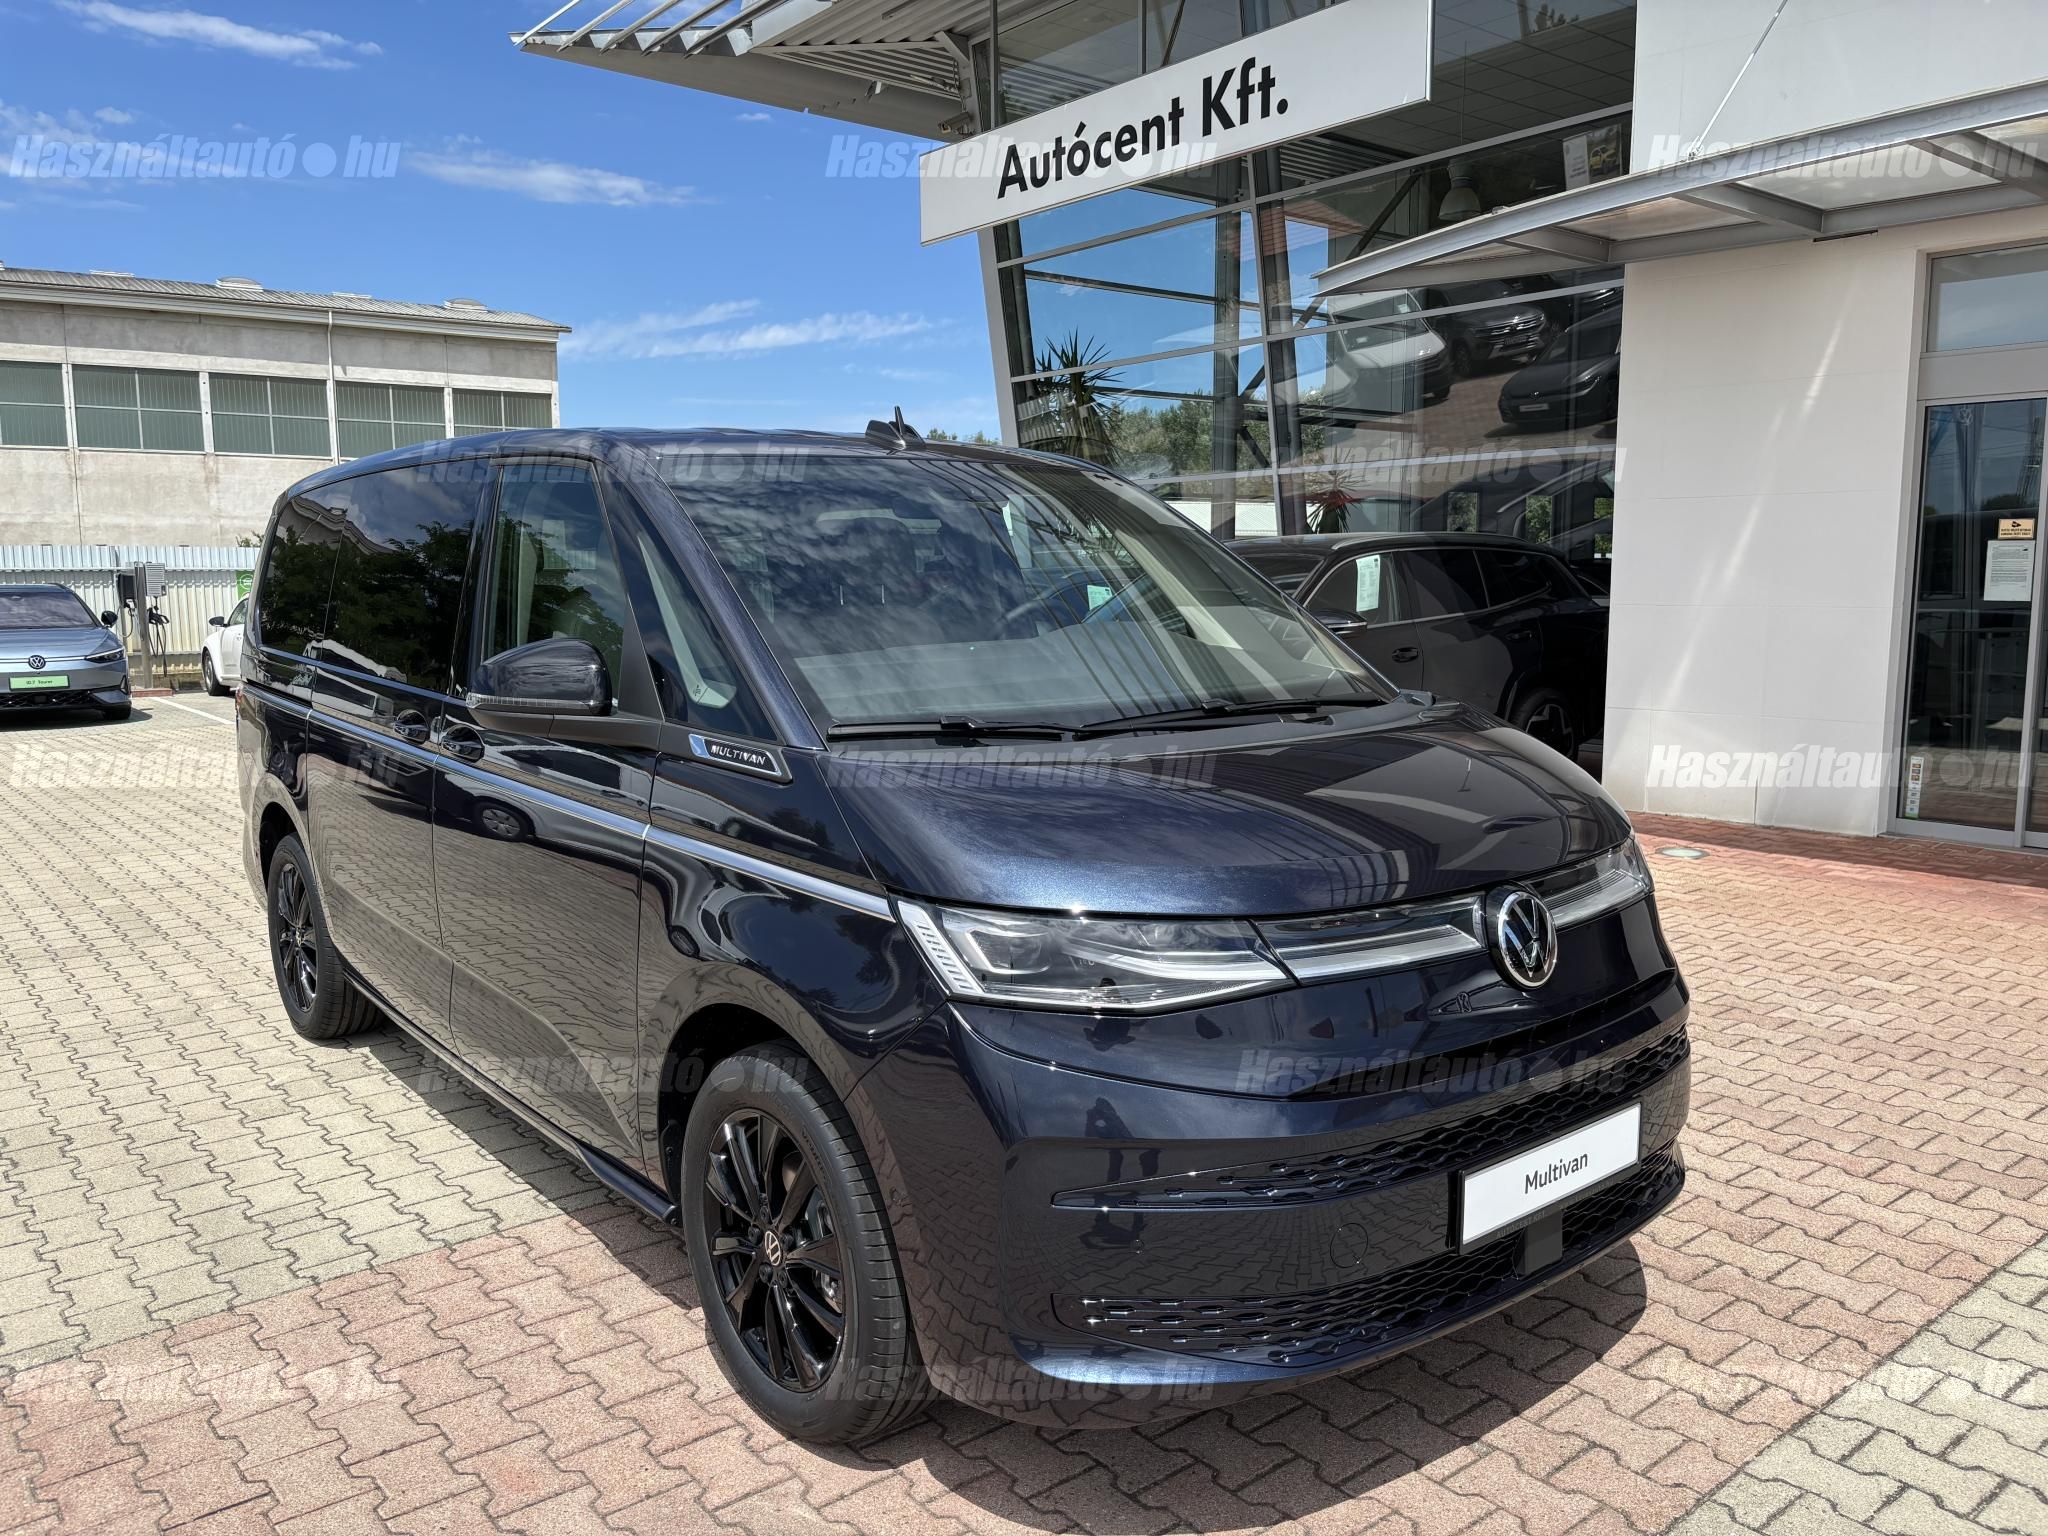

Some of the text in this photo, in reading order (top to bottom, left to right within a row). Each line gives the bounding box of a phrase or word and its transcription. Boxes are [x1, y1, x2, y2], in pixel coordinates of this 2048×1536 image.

[997, 56, 1289, 199] Autócent Kft.
[711, 745, 766, 765] MULTIVAN
[1524, 1153, 1588, 1194] Multivan
